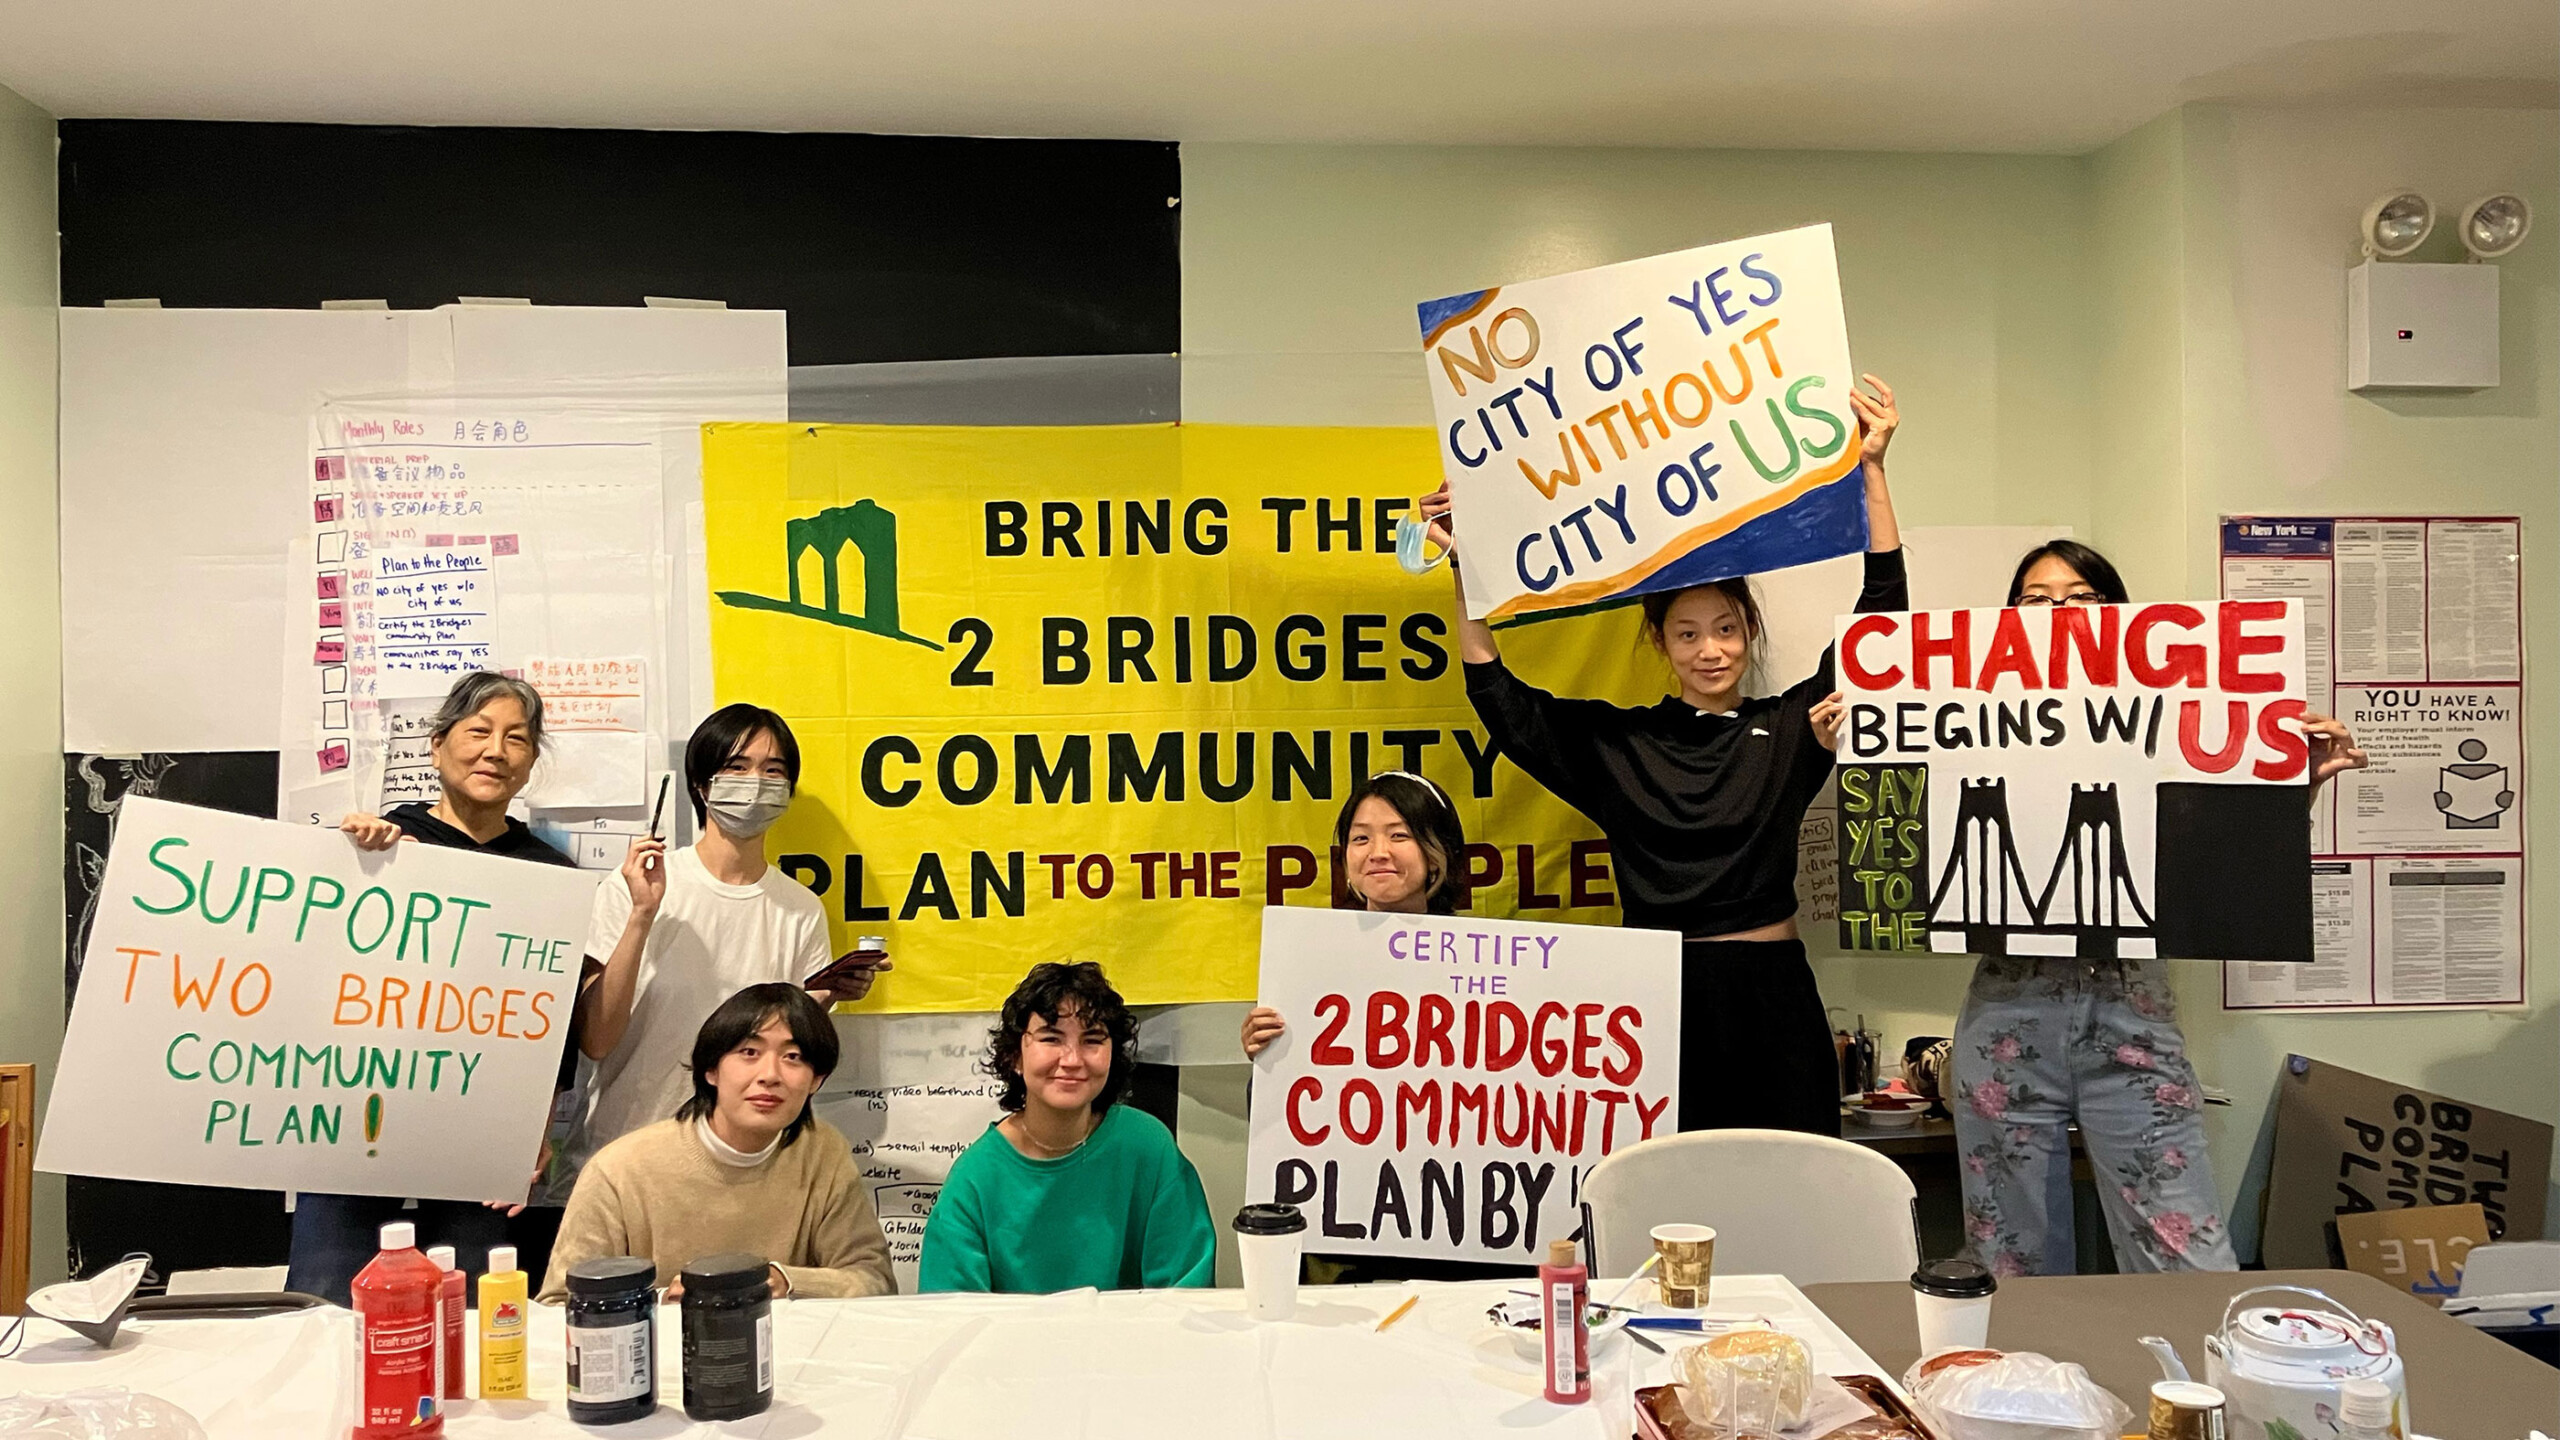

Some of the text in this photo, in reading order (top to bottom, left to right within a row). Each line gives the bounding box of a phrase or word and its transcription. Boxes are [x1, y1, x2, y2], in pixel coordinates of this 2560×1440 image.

[1438, 307, 1540, 396] NO
[1449, 253, 1783, 468] CITY OF YES
[343, 419, 530, 443] Monthly Roles 月会角色
[1517, 318, 1783, 501] WITHOUT
[454, 490, 469, 500] UP
[1516, 375, 1846, 592] CITY OF US
[985, 497, 1410, 557] BRING THE
[2251, 525, 2272, 536] New
[2275, 525, 2298, 536] York
[382, 552, 482, 575] Plan to the People
[393, 585, 412, 598] city
[416, 583, 425, 594] of
[431, 583, 448, 595] yes
[408, 597, 462, 611] city of us
[411, 620, 425, 629] the
[1841, 600, 2289, 693] CHANGE
[470, 646, 489, 658] YES
[948, 612, 1450, 687] 2 BRIDGES
[2355, 709, 2510, 722] RIGHT TO KNOW!
[2365, 689, 2496, 708] YOU HAVE A
[1851, 695, 2310, 782] BEGINS W/ US
[428, 784, 442, 793] Pla
[861, 729, 1496, 808] COMMUNITY
[1841, 767, 1927, 816] SAY
[593, 847, 605, 858] 16
[1846, 815, 1923, 868] YES
[779, 838, 1615, 925] PLAN TO THE PPLE
[1854, 868, 1913, 911] TO
[132, 837, 572, 974] SUPPORT THE
[1388, 930, 1559, 970] CERTIFY
[1840, 910, 1927, 953] THE
[115, 947, 555, 1041] TWO BRIDGES
[1449, 975, 1507, 996] THE
[166, 1032, 482, 1096] COMMUNITY
[1286, 1076, 1670, 1157] COMMUNITY
[895, 1141, 925, 1154] email
[929, 1142, 971, 1159] templa
[2470, 1150, 2509, 1240] TWO
